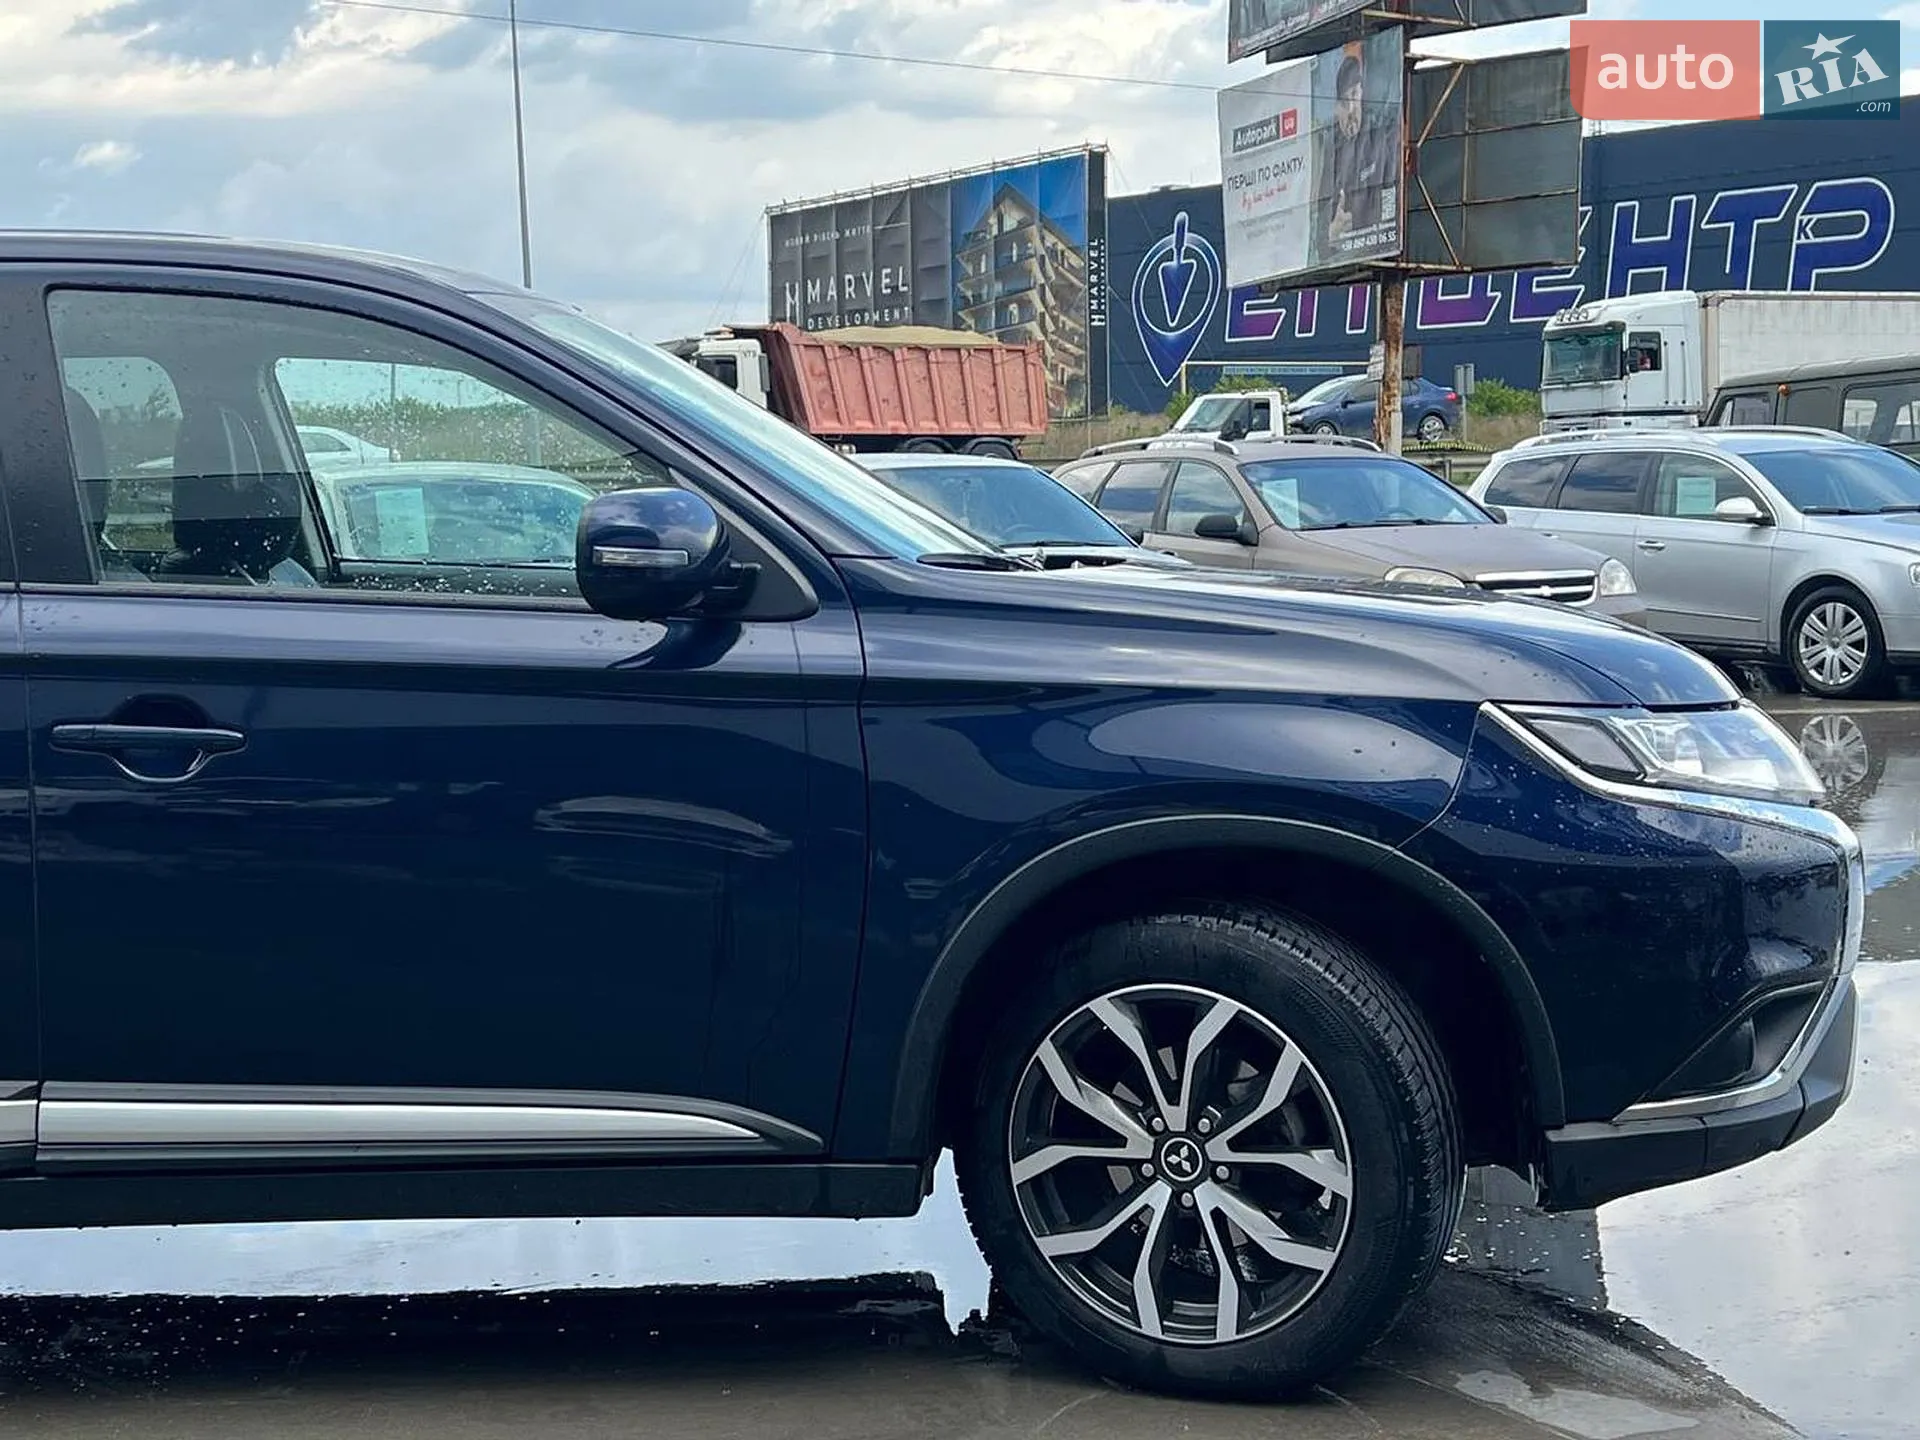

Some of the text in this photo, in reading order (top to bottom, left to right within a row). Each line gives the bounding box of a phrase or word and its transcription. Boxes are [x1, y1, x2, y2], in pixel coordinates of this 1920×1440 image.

[1234, 118, 1278, 149] Autopark
[1257, 165, 1271, 185] ПО
[806, 266, 910, 305] MARVEL
[1088, 238, 1099, 311] MARVEL
[806, 305, 910, 331] DEVELOPMENT
